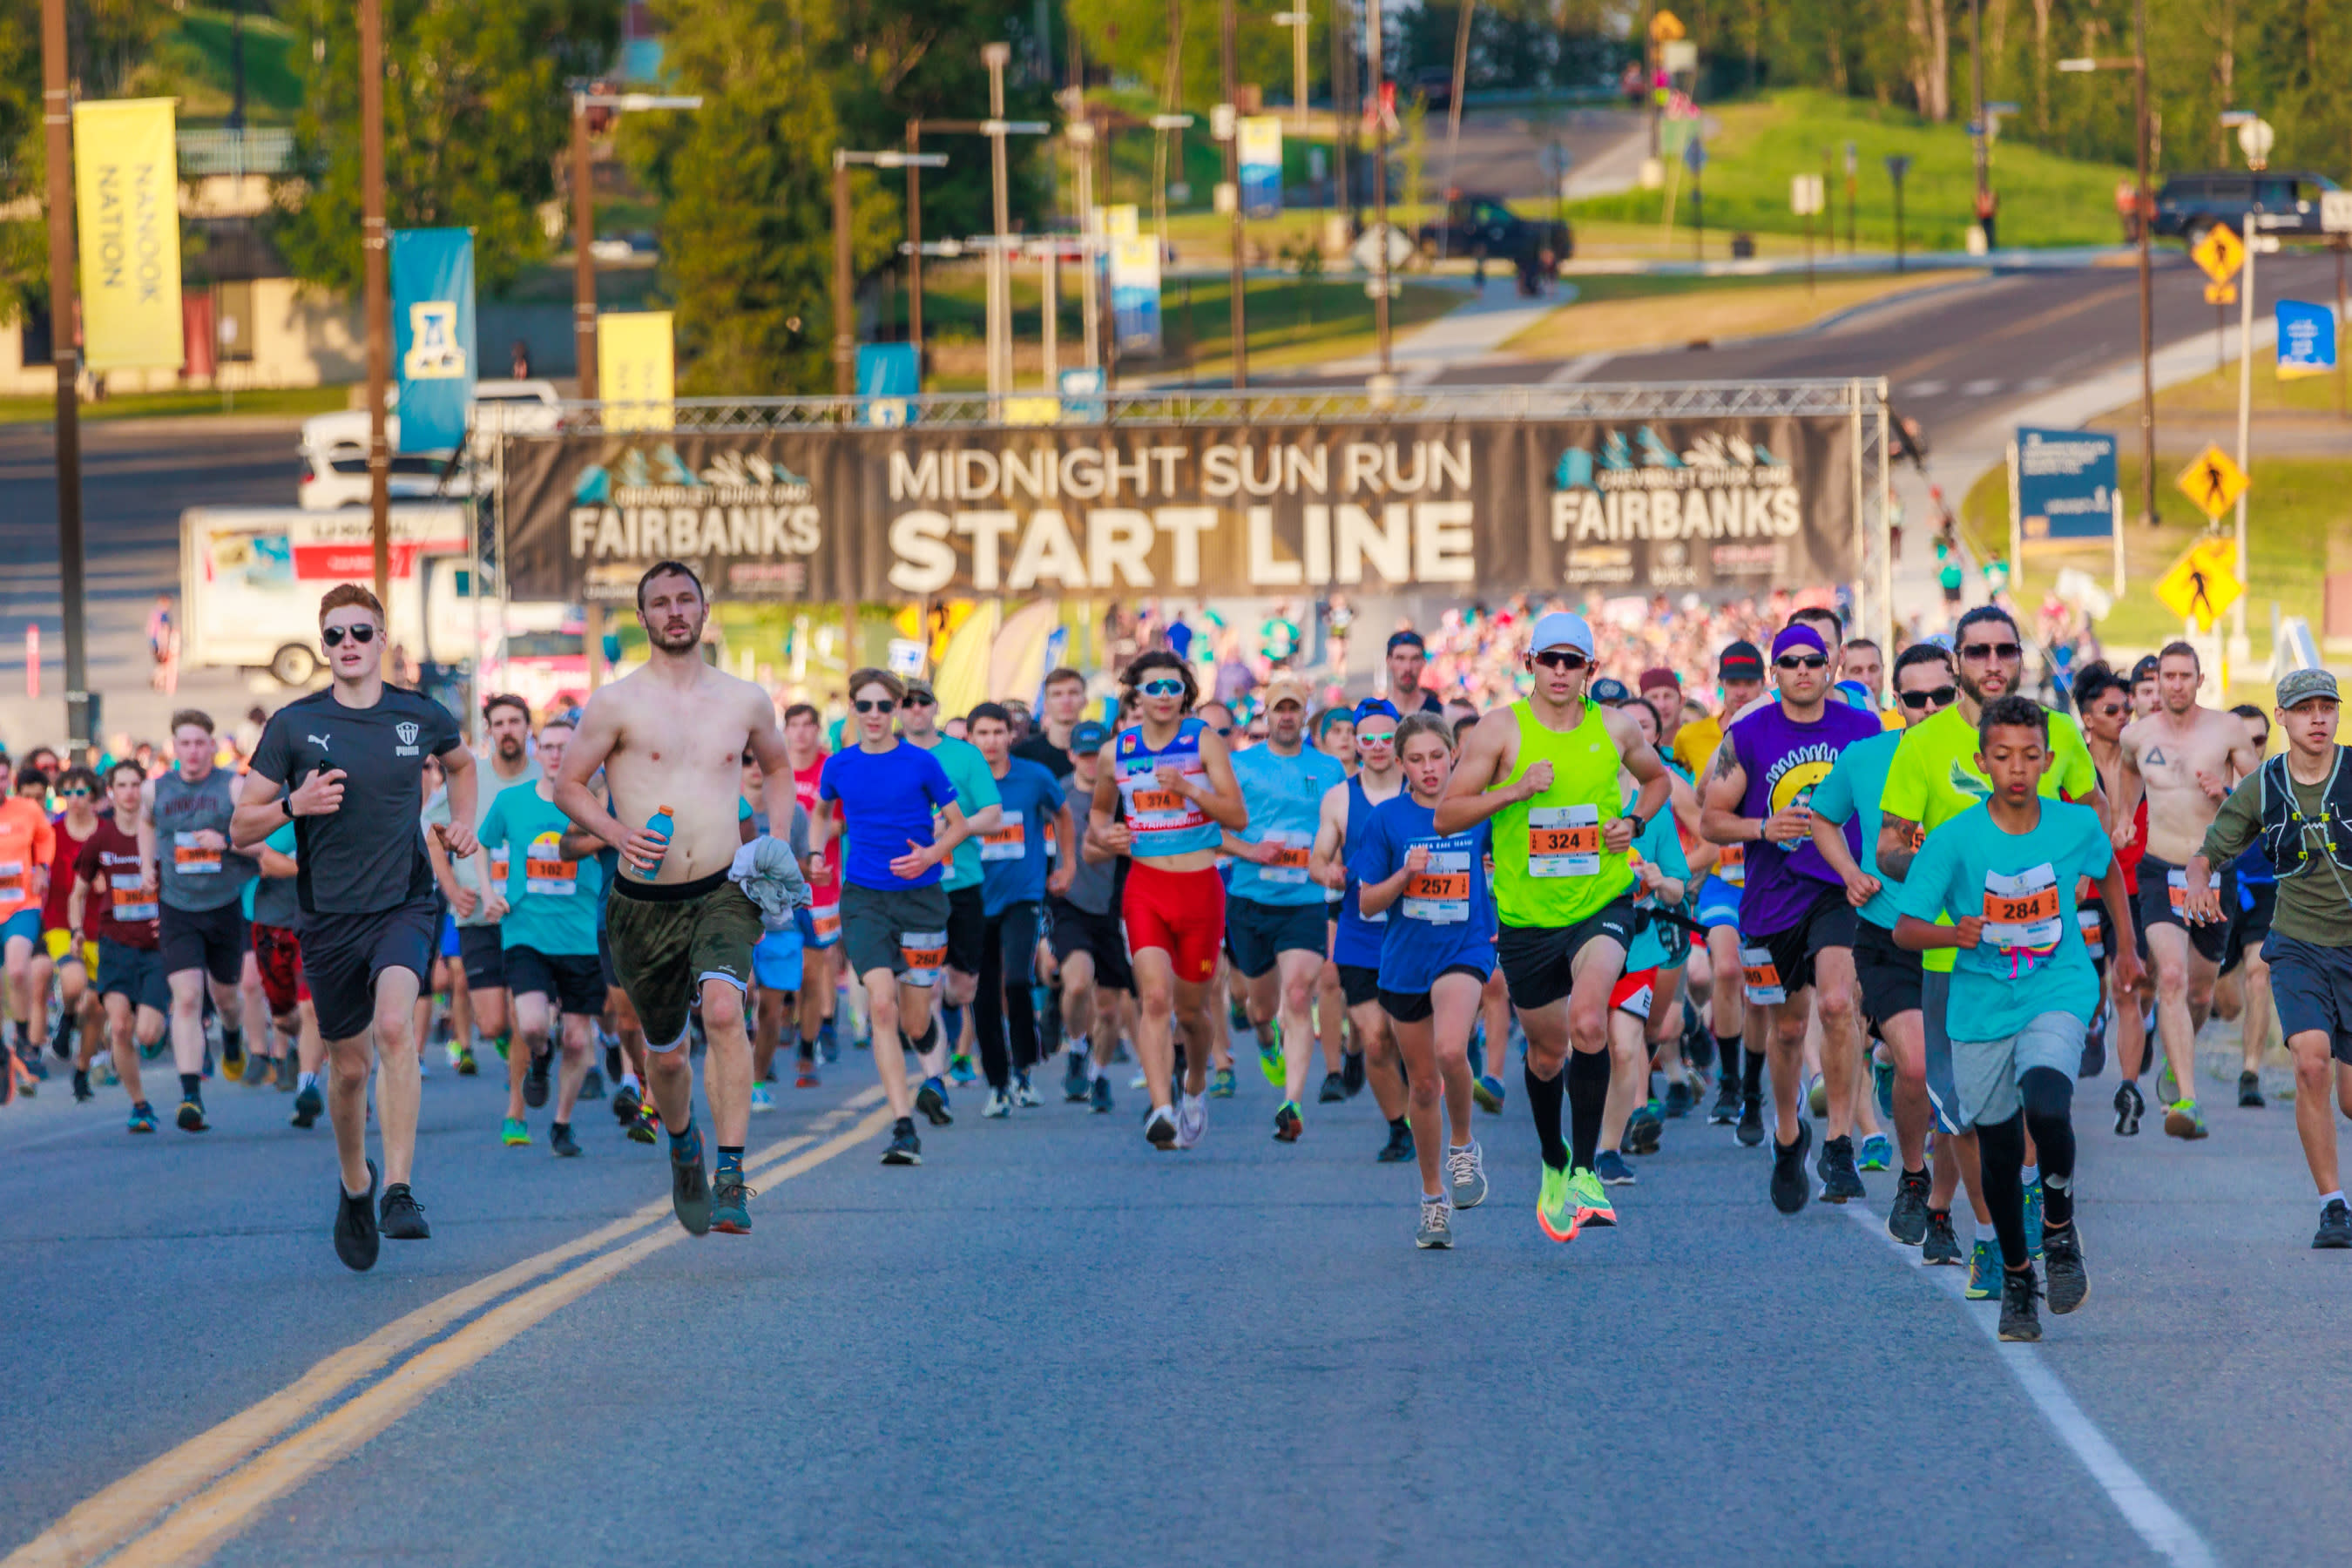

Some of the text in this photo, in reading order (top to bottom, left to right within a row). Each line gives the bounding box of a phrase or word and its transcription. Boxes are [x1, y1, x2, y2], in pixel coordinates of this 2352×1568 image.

[98, 164, 125, 287] NATION
[136, 163, 164, 304] NANOOK
[889, 439, 1471, 501] MIDNIGHT SUN RUN
[570, 505, 822, 558] FAIRBANKS
[1551, 487, 1801, 541] FAIRBANKS
[888, 501, 1476, 592] START LINE
[1548, 833, 1580, 849] 324
[1421, 879, 1451, 896] 257
[2004, 899, 2040, 920] 284
